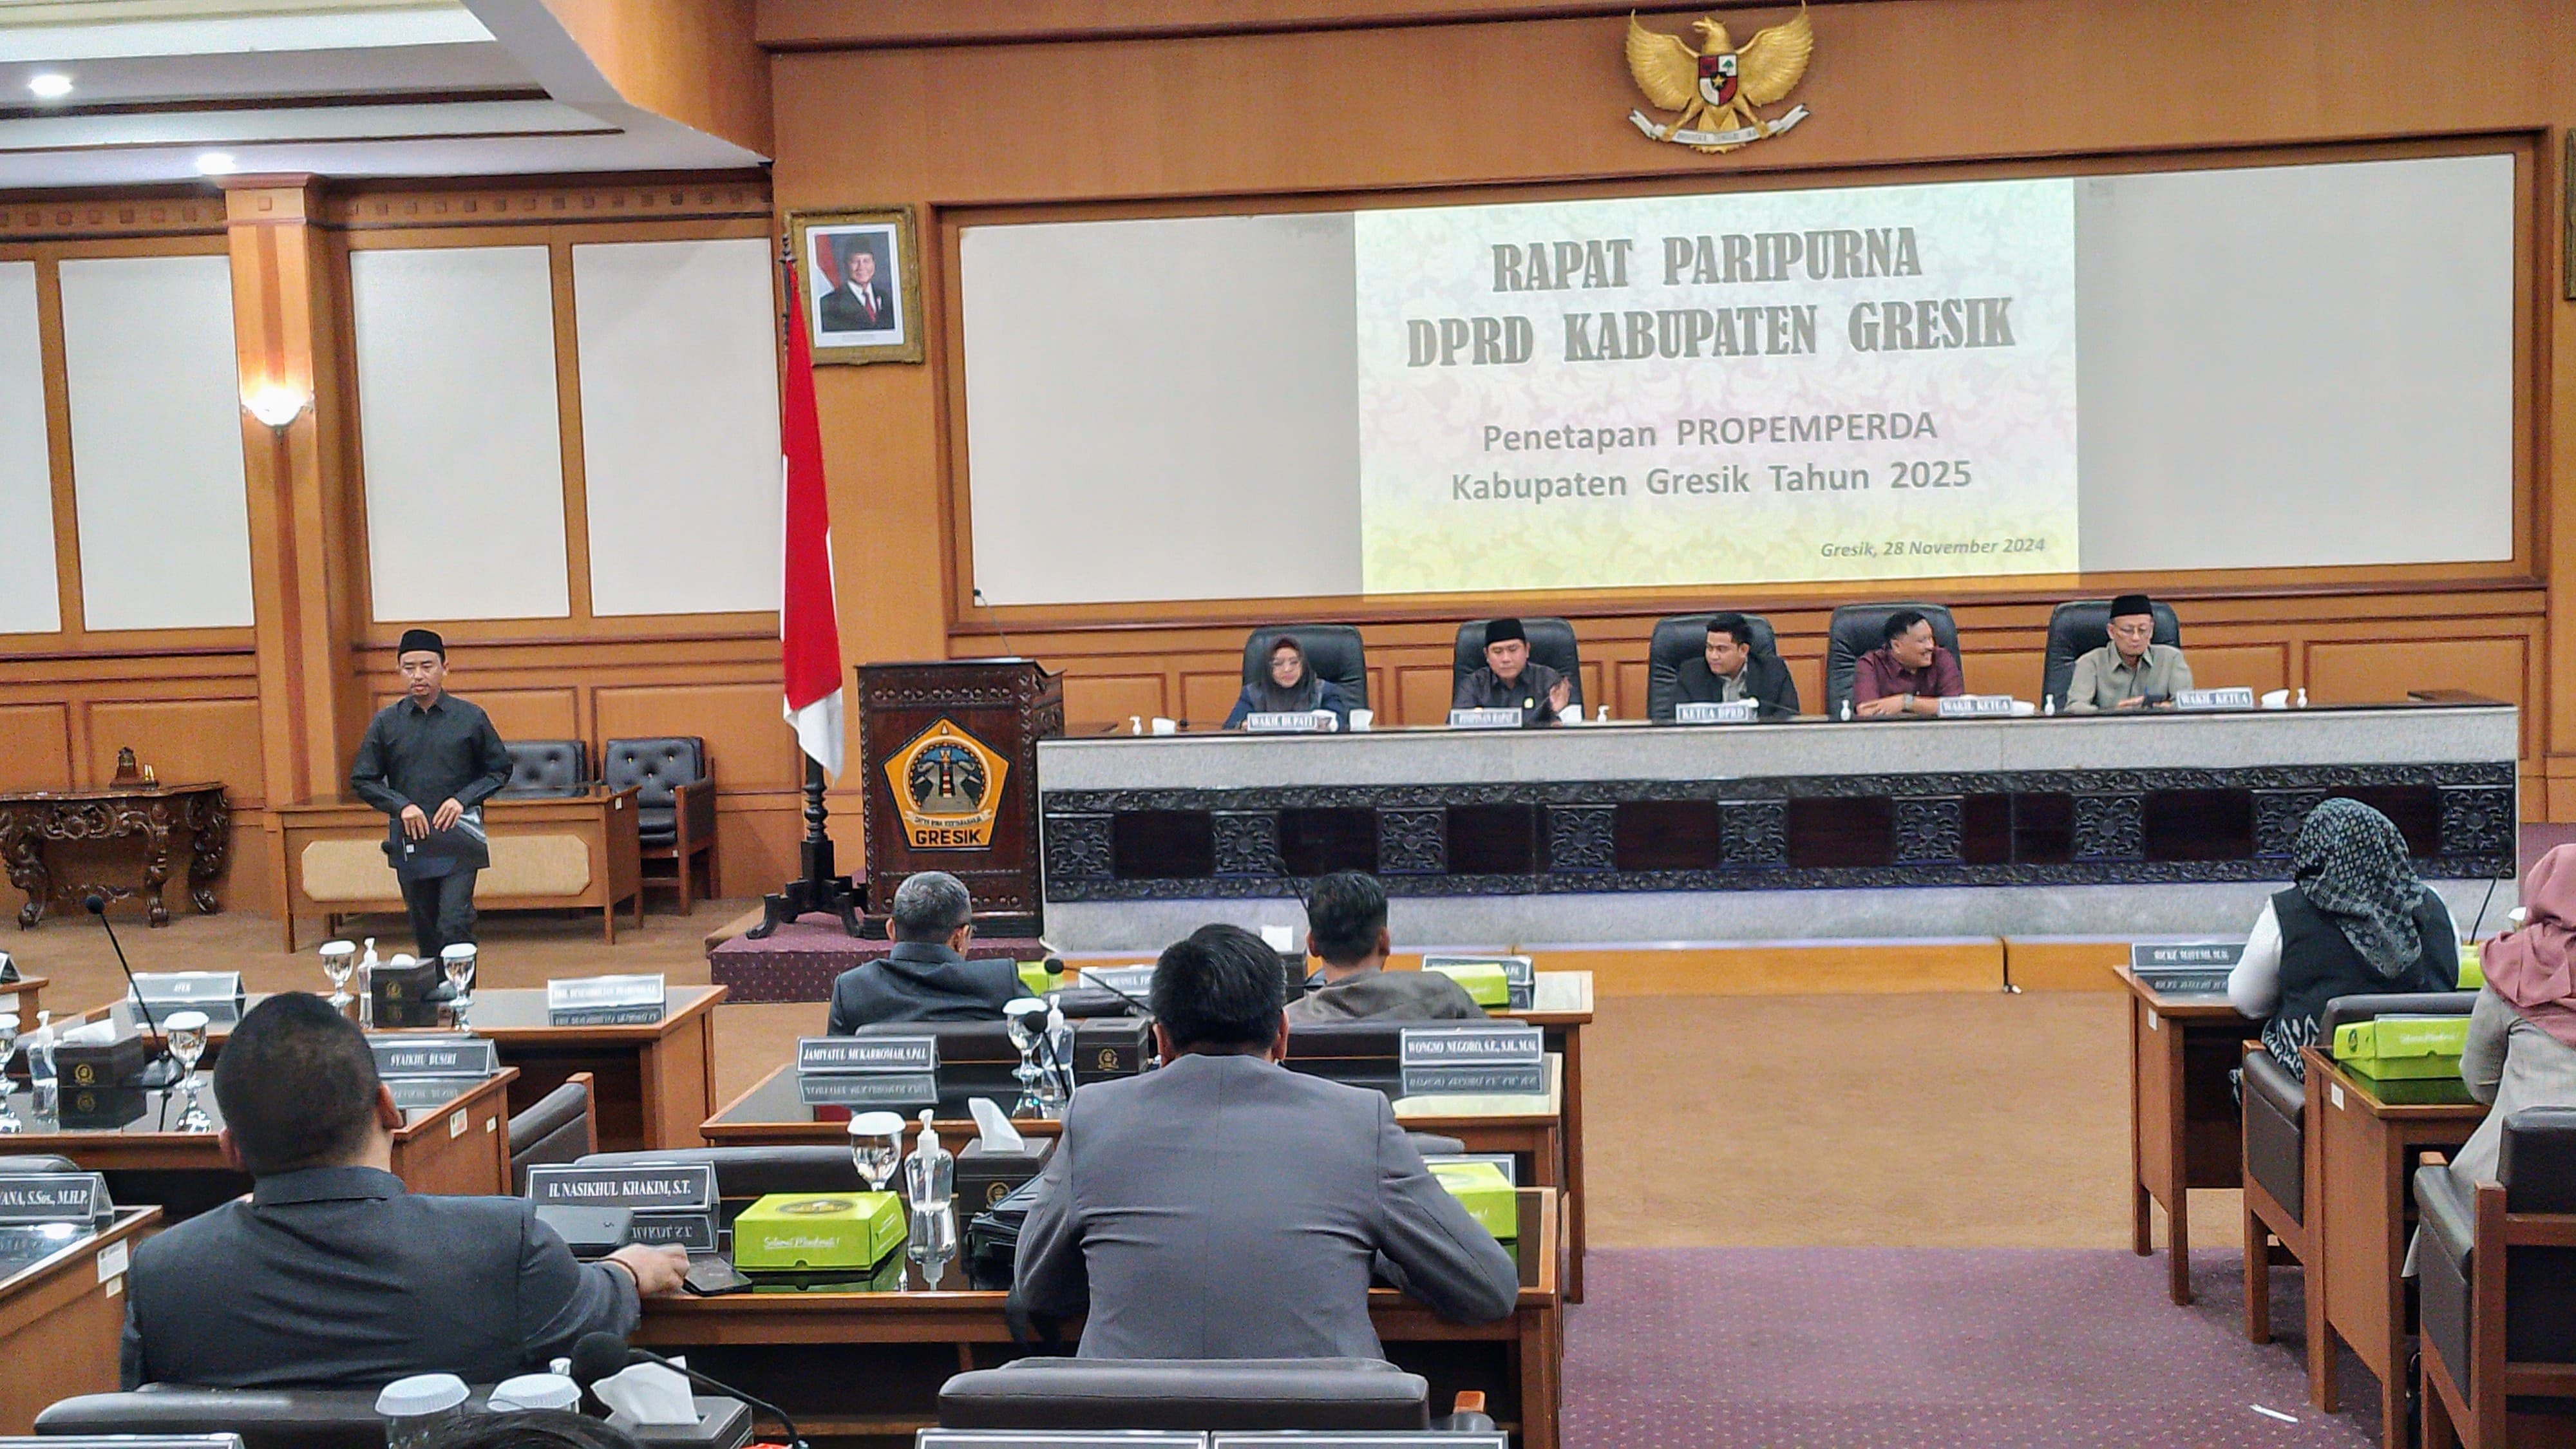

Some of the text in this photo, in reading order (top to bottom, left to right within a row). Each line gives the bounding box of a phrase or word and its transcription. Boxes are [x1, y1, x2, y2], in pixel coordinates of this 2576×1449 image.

[1492, 227, 1922, 292] RAPAT PARIPURNA
[1407, 297, 2015, 367] DPRD KABUPATEN GRESIK
[1484, 412, 1938, 454] Penetapan PROPEMPERDA
[1453, 460, 1971, 504] Kabupaten Gresik Tahun 2025
[1821, 538, 2045, 558] Gresik, 28 November 2024
[916, 829, 981, 845] GRESIK
[561, 1181, 618, 1197] NASIKHUL
[673, 1179, 692, 1195] S.T.
